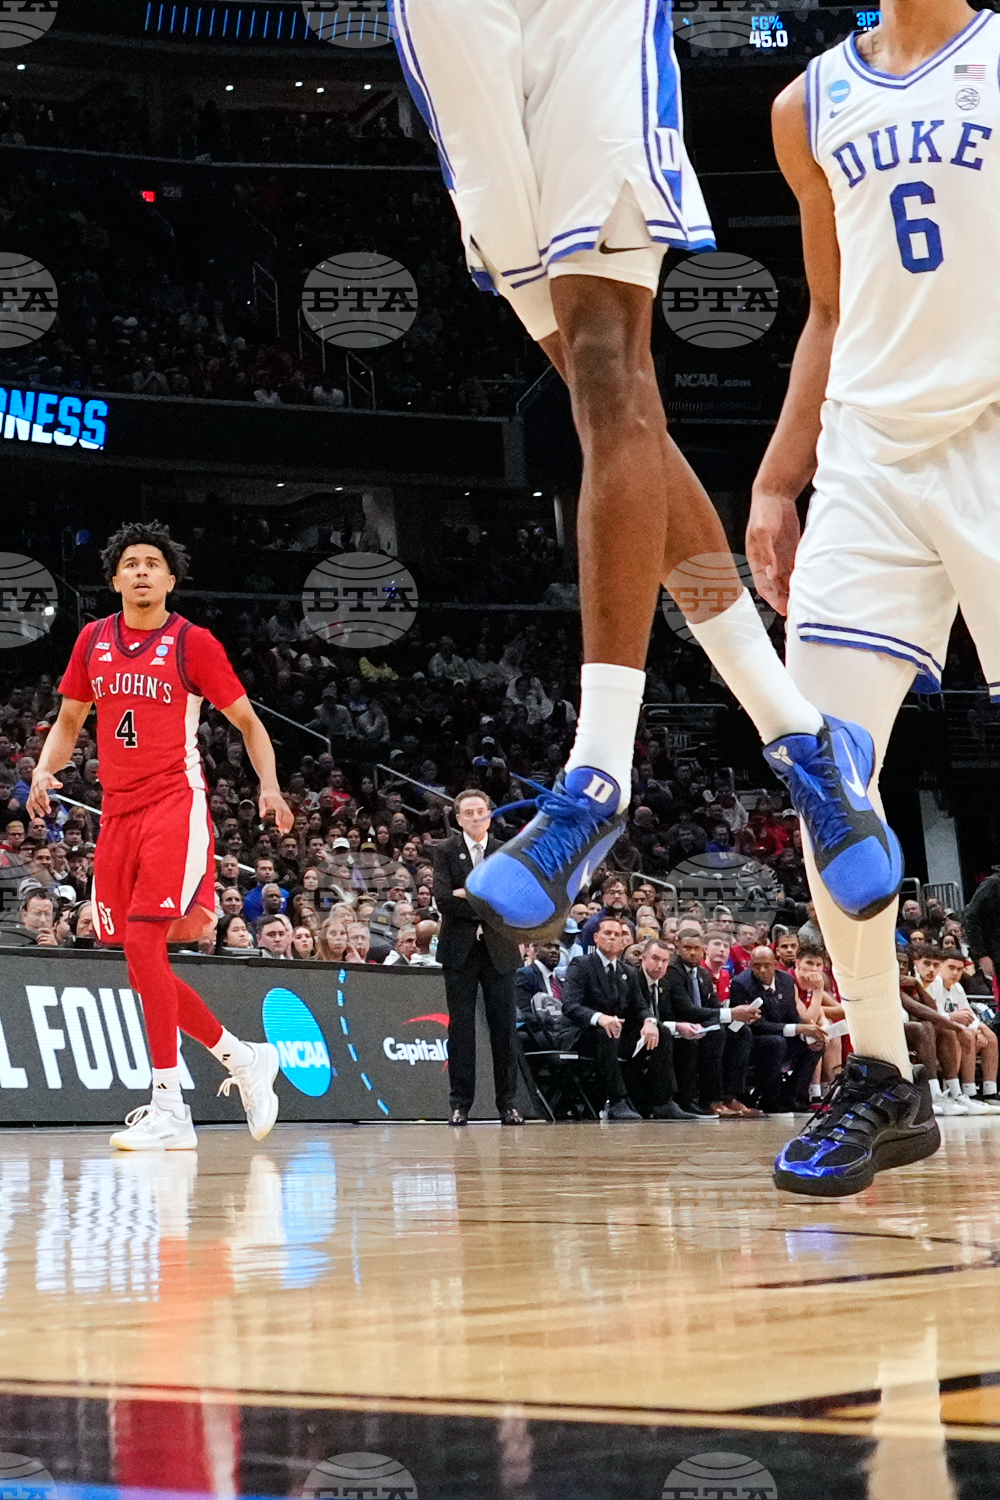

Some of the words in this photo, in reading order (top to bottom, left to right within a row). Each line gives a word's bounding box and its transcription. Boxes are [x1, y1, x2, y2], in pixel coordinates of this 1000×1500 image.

[751, 15, 783, 31] FG%
[749, 30, 789, 49] 45.0
[832, 120, 993, 189] DUKE
[890, 181, 944, 274] 6
[109, 672, 172, 704] JOHN'S
[115, 709, 138, 748] 4
[276, 1040, 330, 1069] NCAA
